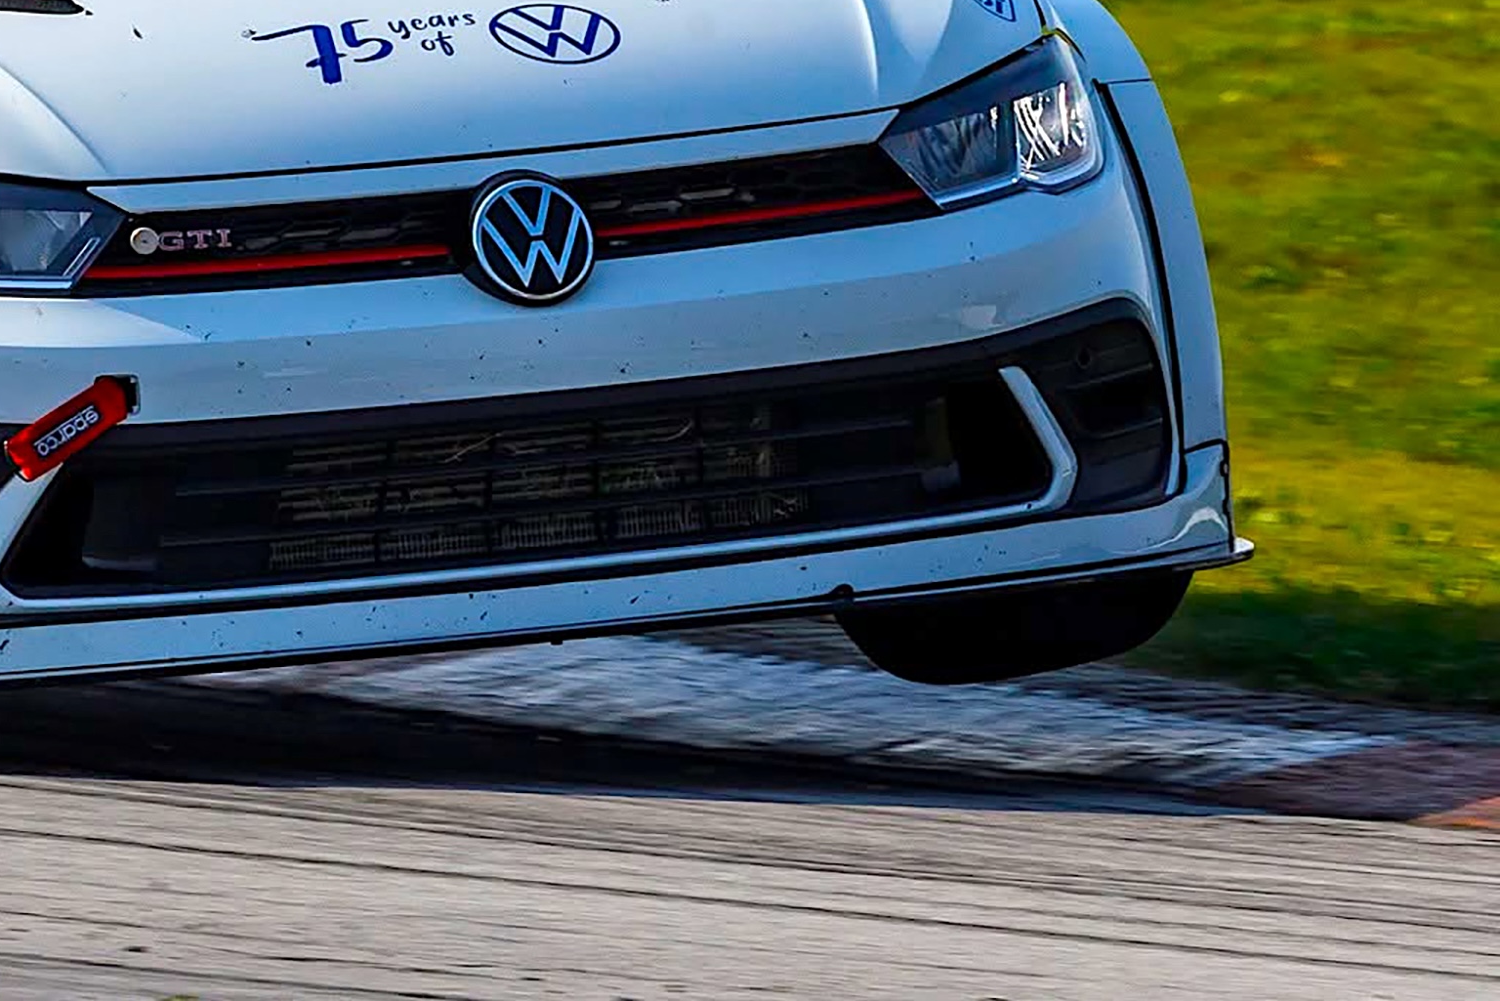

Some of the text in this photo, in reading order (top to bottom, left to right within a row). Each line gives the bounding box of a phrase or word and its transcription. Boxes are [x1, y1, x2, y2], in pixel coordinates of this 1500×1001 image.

[387, 11, 476, 39] years
[251, 14, 394, 84] 75
[421, 31, 455, 56] of
[159, 228, 232, 252] GTI
[37, 409, 100, 457] sparco
